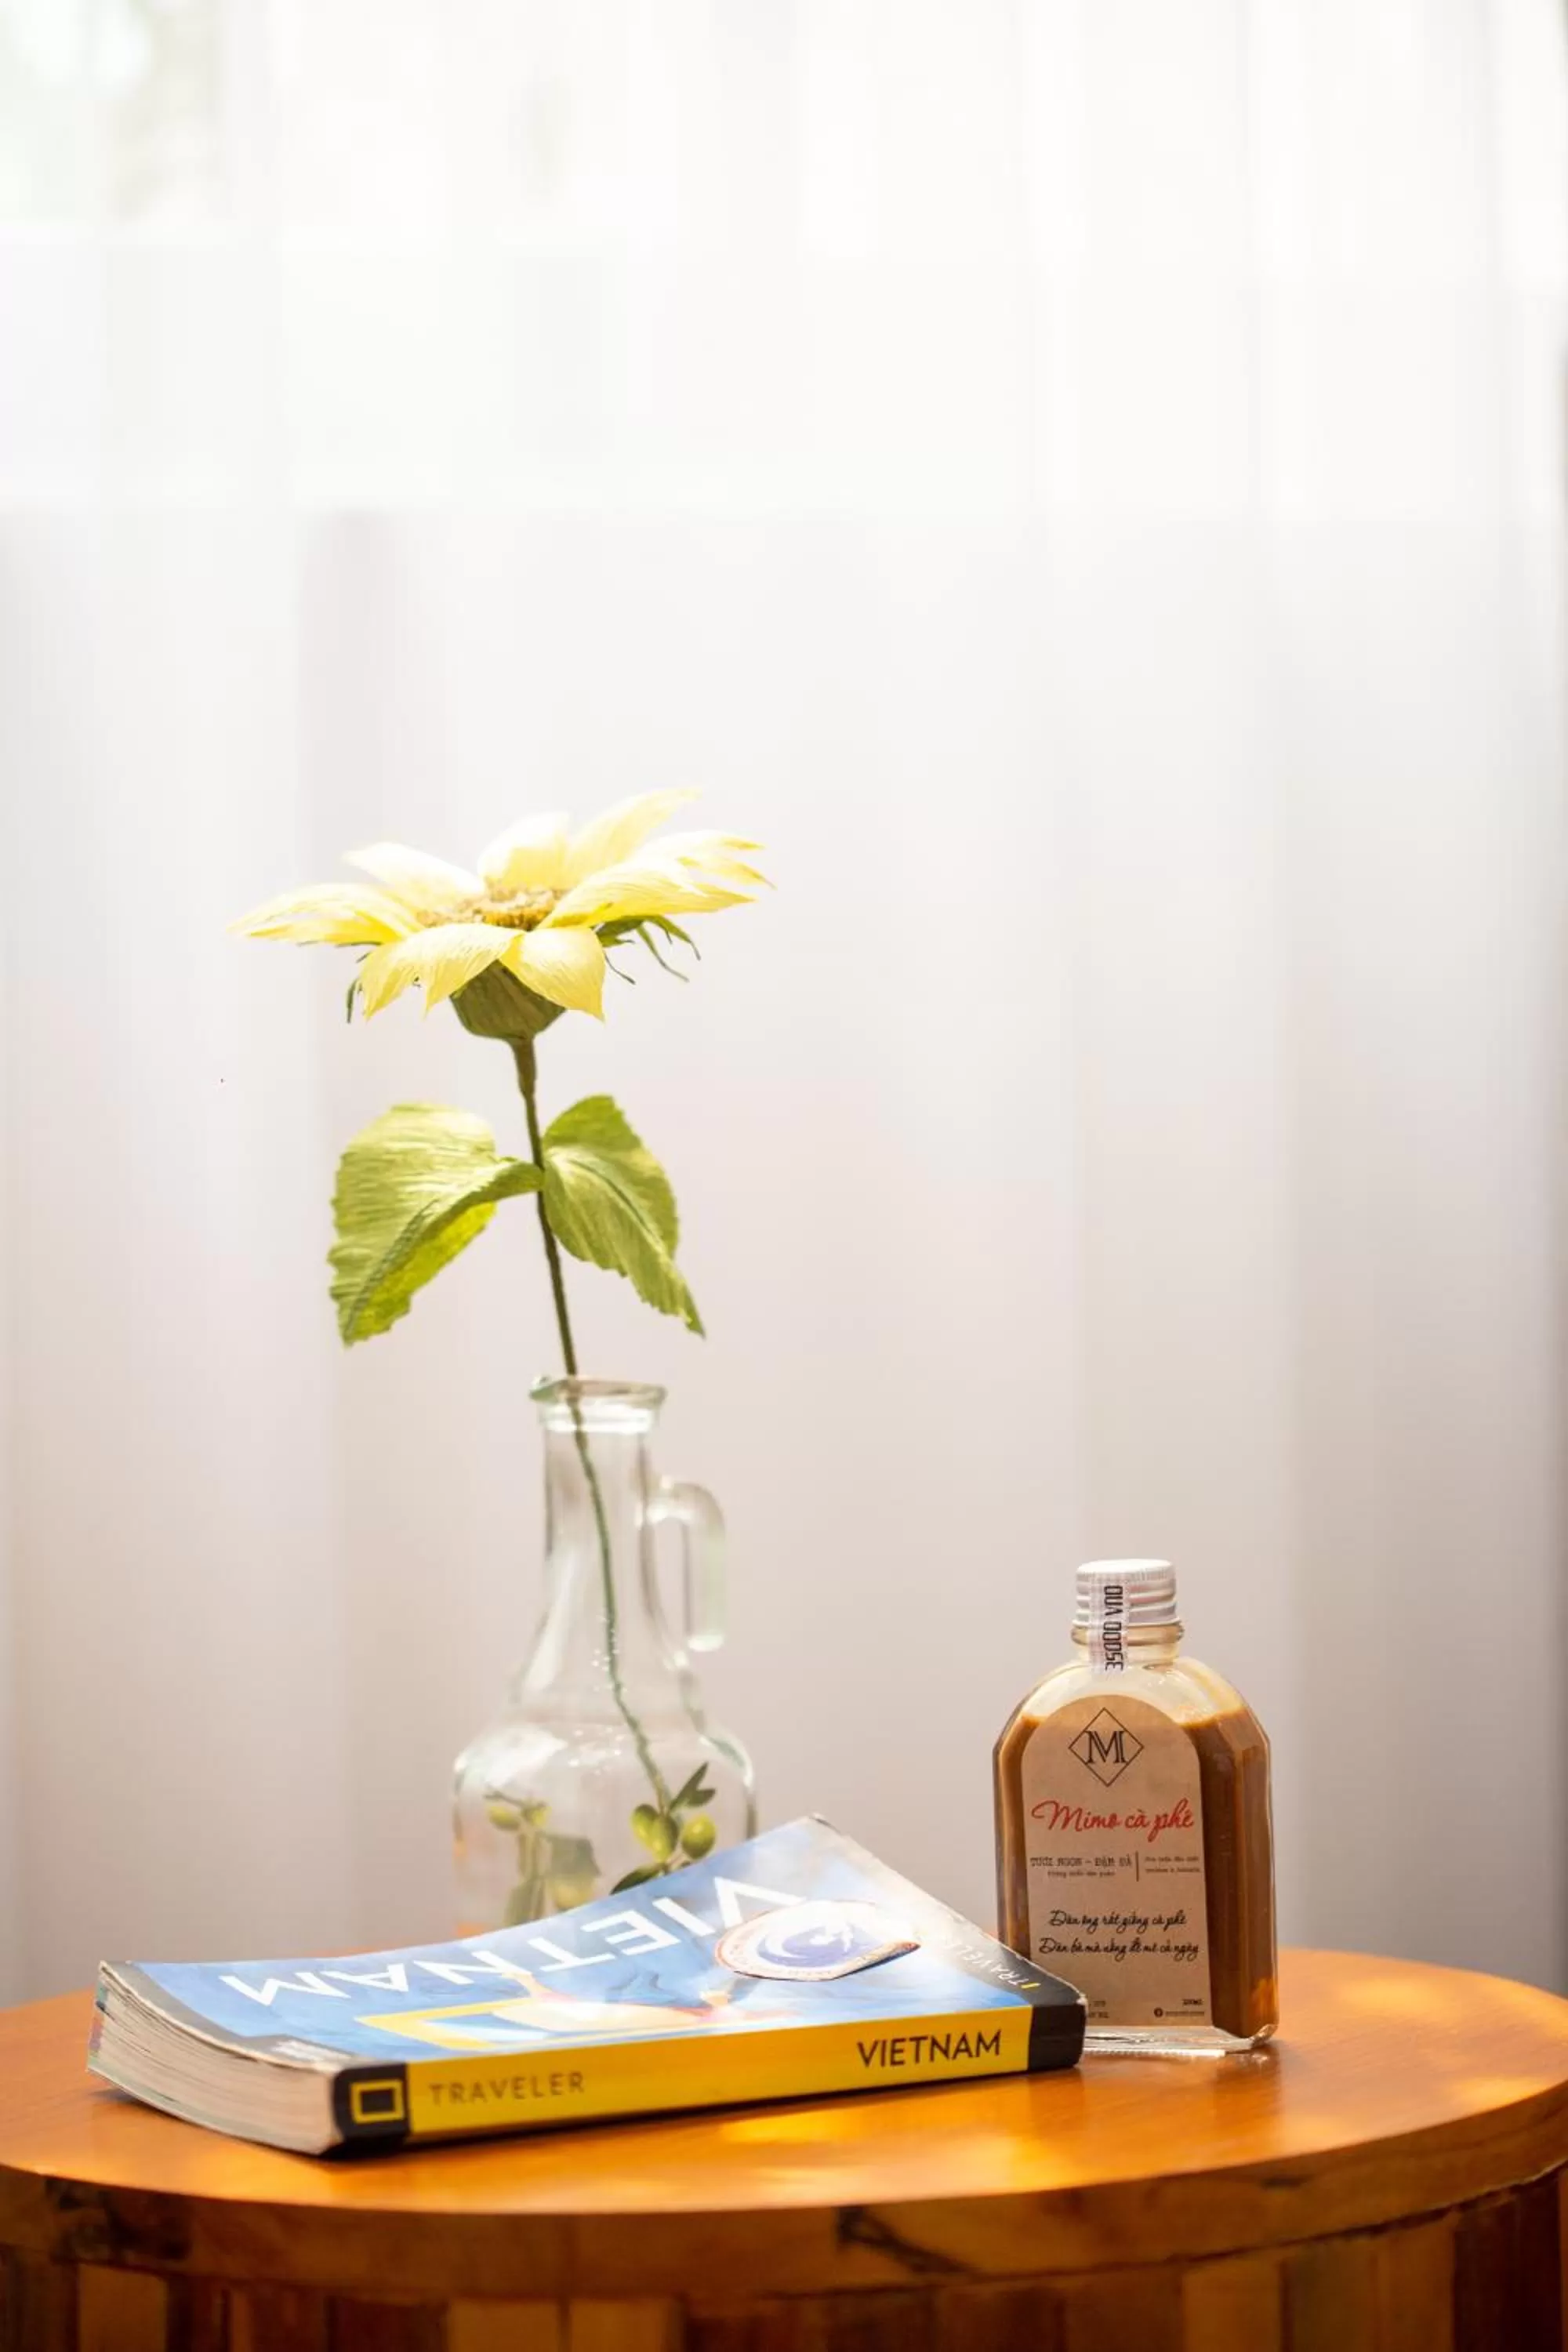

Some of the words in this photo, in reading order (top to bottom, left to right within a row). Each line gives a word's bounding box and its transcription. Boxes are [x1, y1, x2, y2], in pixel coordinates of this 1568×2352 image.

[1103, 1584, 1123, 1617] VND
[1102, 1621, 1123, 1671] 35000
[1031, 1800, 1120, 1832] Mimo
[1124, 1809, 1150, 1829] cà
[219, 1875, 808, 2007] VIETNAM
[857, 2029, 1002, 2069] VIETNAM
[429, 2071, 586, 2106] TRAVELER
